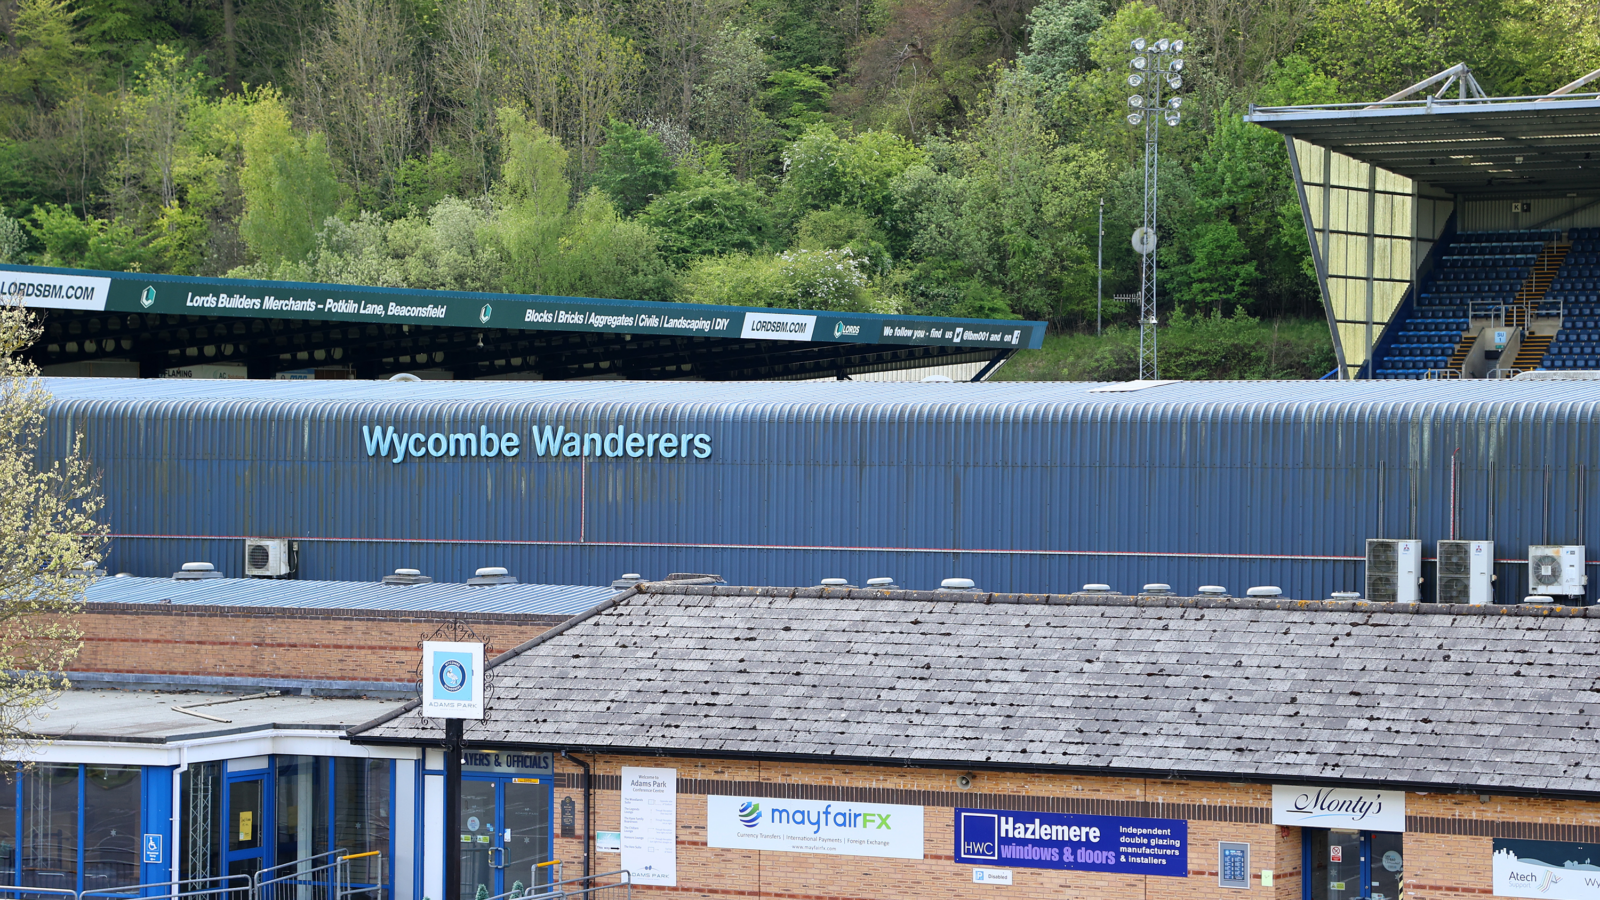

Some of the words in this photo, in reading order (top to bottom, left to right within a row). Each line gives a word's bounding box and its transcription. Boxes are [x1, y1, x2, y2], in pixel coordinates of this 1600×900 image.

[0, 281, 95, 301] LORDSBM.COM
[186, 292, 217, 307] Lords
[218, 293, 261, 309] Builders
[262, 296, 316, 312] Merchants
[324, 299, 358, 314] Potkiln
[360, 301, 386, 317] Lane,
[387, 302, 447, 318] Beaconsfield
[524, 309, 553, 322] Blocks
[558, 310, 584, 324] Bricks
[588, 312, 634, 328] Aggregates
[638, 314, 660, 327] Civils
[664, 316, 710, 332] Landscaping
[715, 318, 730, 331] DIY
[751, 320, 807, 334] LORDSBM.COM
[843, 325, 860, 334] LORDS
[883, 326, 894, 336] We
[894, 327, 912, 337] follow
[913, 329, 926, 339] you
[930, 328, 943, 338] find
[990, 332, 1002, 342] and
[362, 424, 520, 464] Wycombe
[532, 424, 712, 459] Wanderers
[464, 752, 490, 766] AYERS
[494, 754, 502, 767] &
[506, 754, 549, 769] OFFICIALS
[1291, 788, 1382, 820] Monty's
[771, 804, 892, 834] mayfairFX
[737, 831, 758, 840] Currency
[759, 832, 781, 840] Transfers
[786, 834, 817, 842] International
[818, 836, 842, 844] Payments
[1000, 816, 1100, 843] Hazlemere
[1120, 826, 1171, 836] Independent
[965, 842, 993, 855] HWC
[1120, 836, 1148, 844] double
[1150, 837, 1181, 848] glazing
[1120, 845, 1180, 855] manufacturers
[1001, 843, 1060, 861] windows
[1063, 846, 1074, 862] &
[1077, 847, 1116, 865] doors
[1128, 855, 1167, 864] installers
[1509, 871, 1536, 882] Atech
